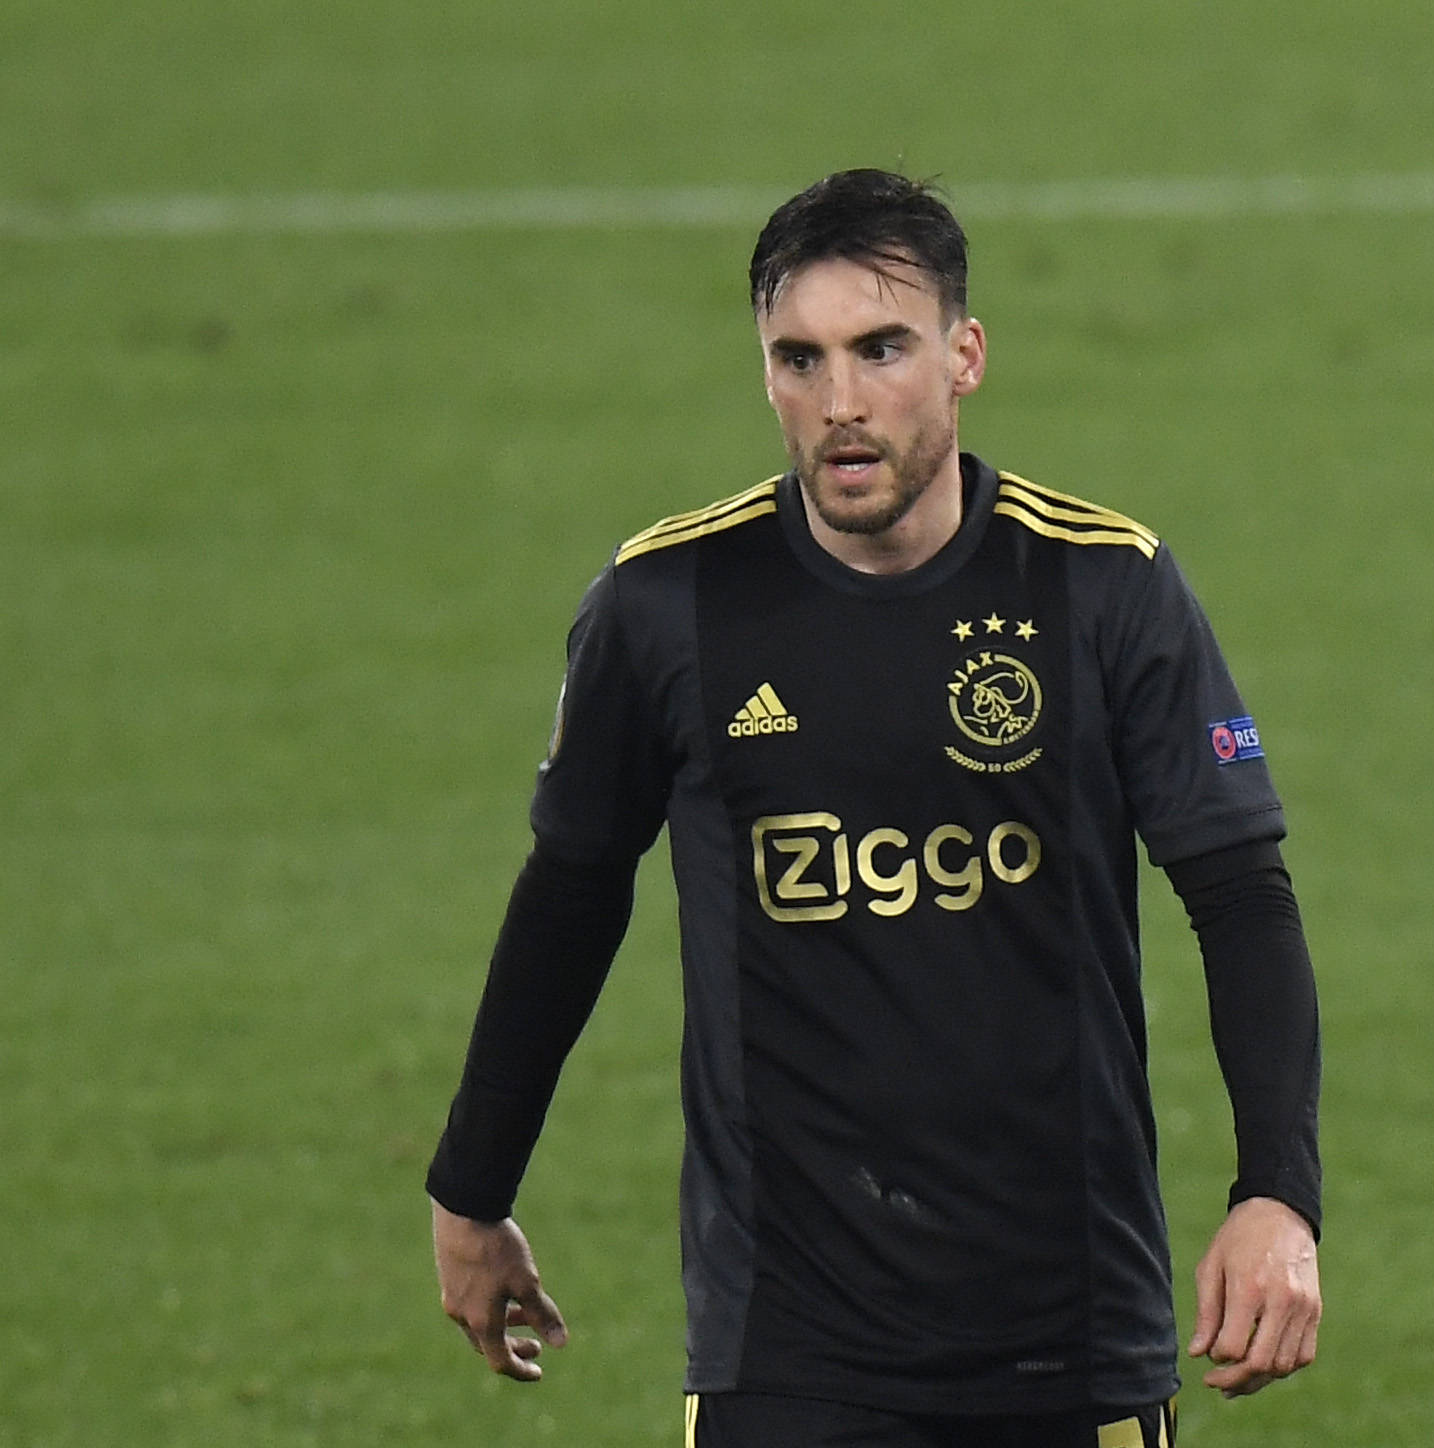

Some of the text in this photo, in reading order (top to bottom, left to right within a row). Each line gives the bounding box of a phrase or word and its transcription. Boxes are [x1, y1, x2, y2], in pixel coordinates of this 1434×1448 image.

[947, 651, 994, 696] AJAX
[727, 715, 799, 738] adidas
[753, 812, 1042, 922] Ziggo
